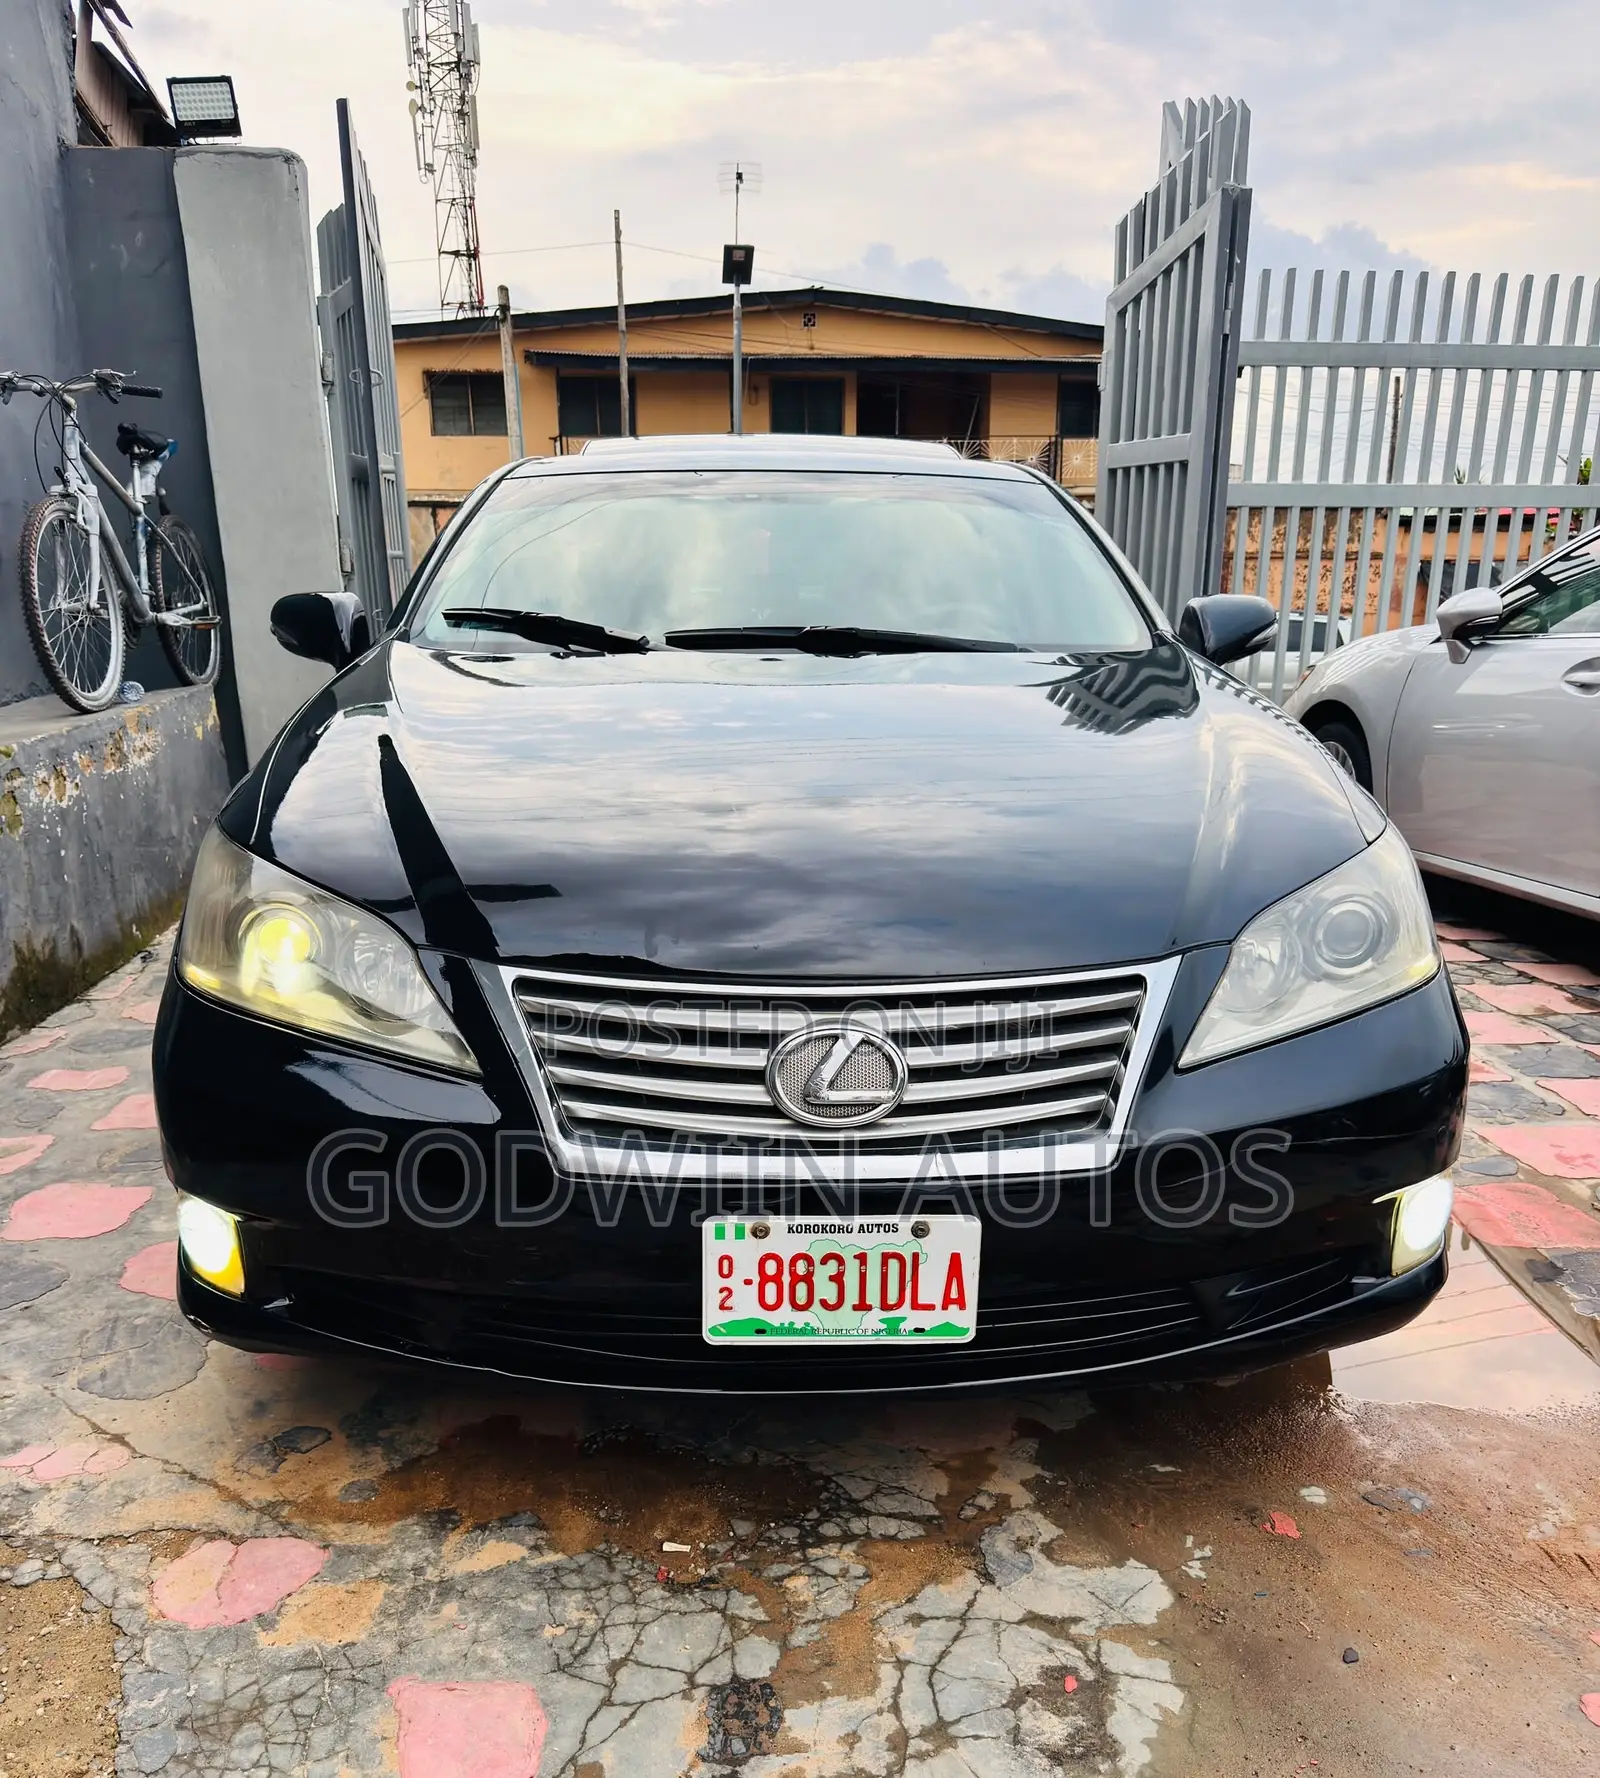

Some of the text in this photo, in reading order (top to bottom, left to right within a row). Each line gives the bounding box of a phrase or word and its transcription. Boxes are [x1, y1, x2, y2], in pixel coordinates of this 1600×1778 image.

[787, 1223, 899, 1234] KOROKORO AUTOS
[811, 1327, 855, 1335] REPUBLIC
